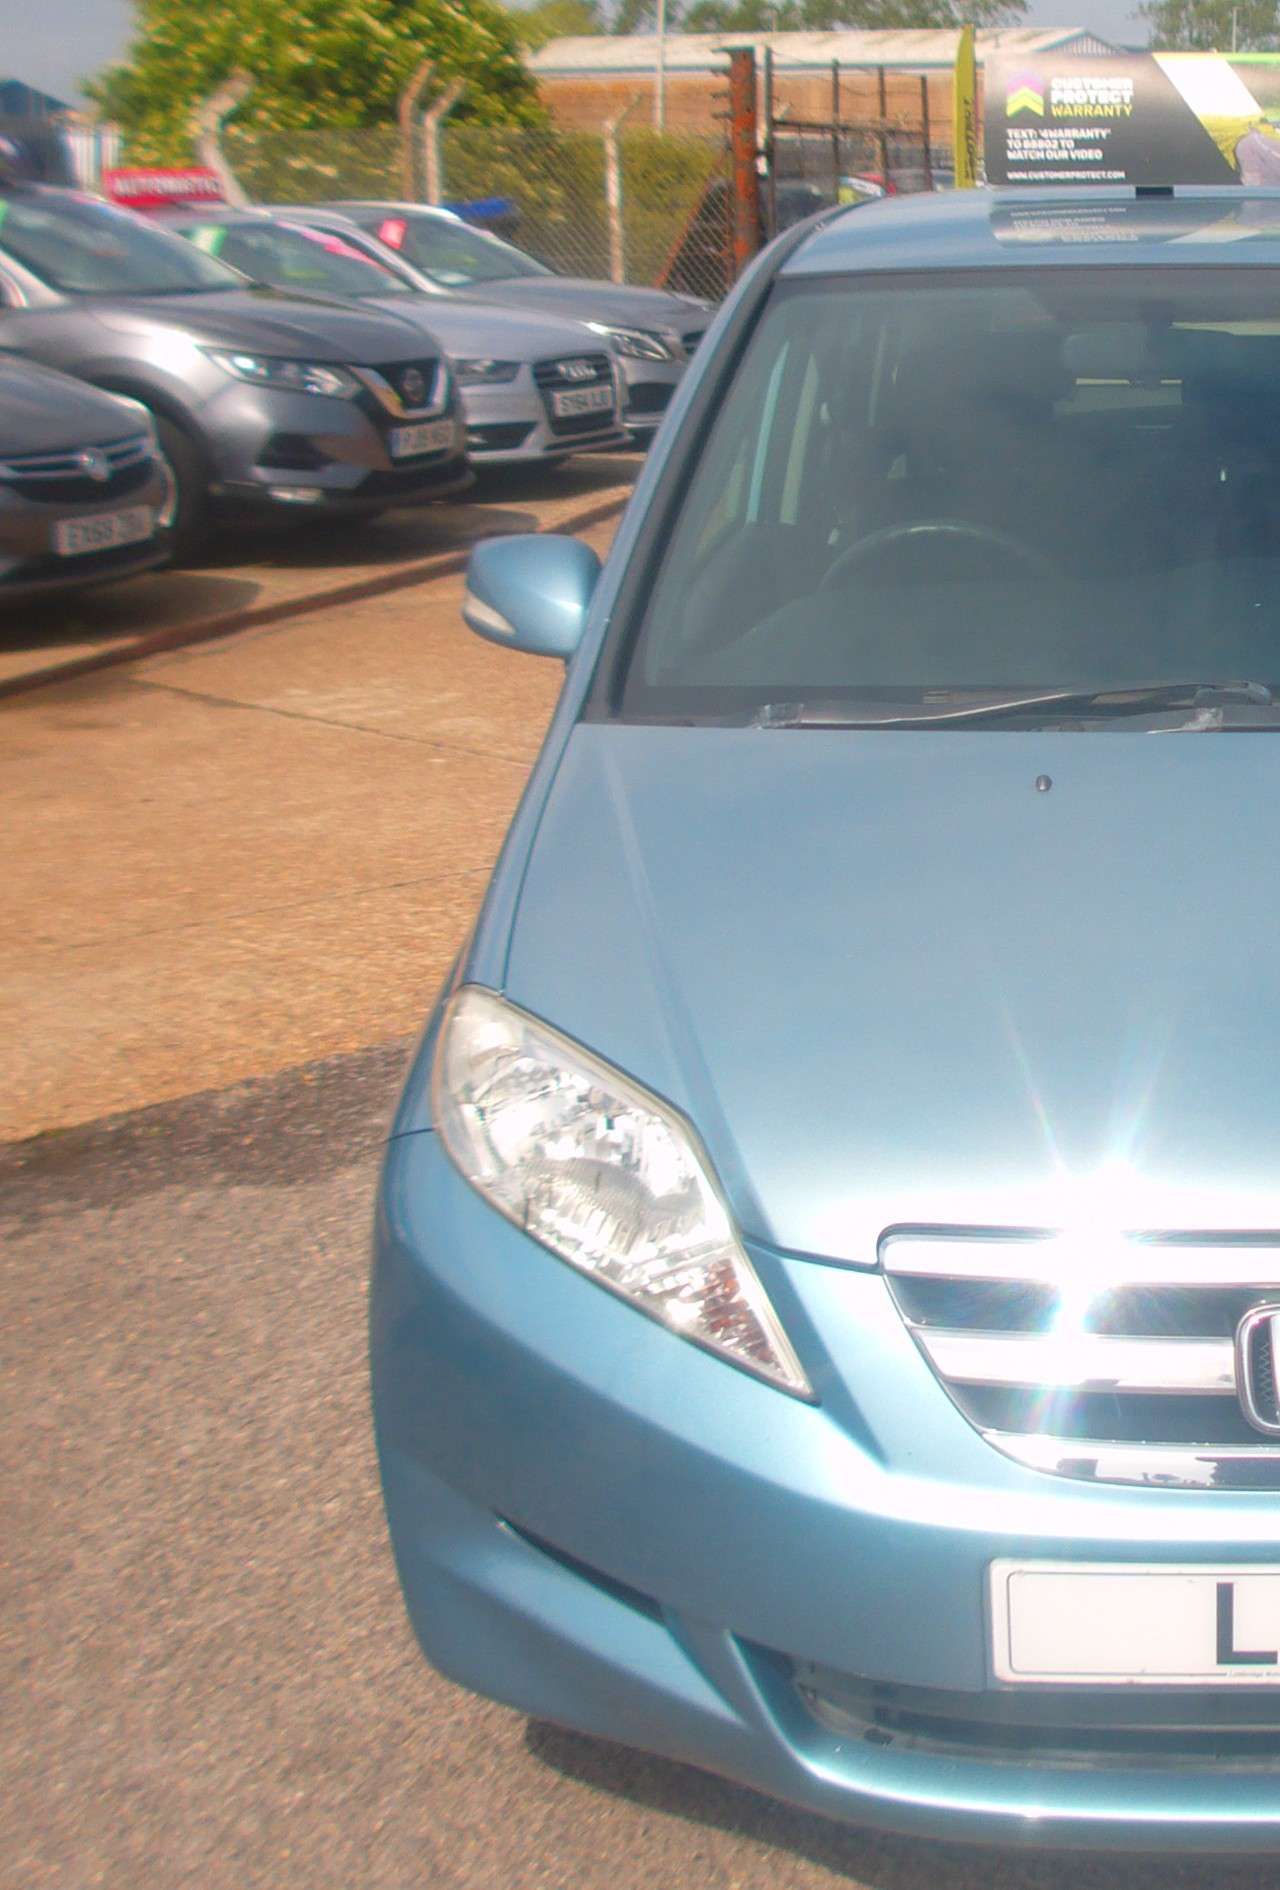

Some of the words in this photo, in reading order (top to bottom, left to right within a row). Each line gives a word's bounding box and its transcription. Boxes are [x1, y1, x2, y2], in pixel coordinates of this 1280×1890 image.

[1050, 89, 1133, 105] PROTECT
[1051, 104, 1133, 117] WARRANTY
[1046, 149, 1069, 160] OUR
[1070, 148, 1104, 160] VIDEO
